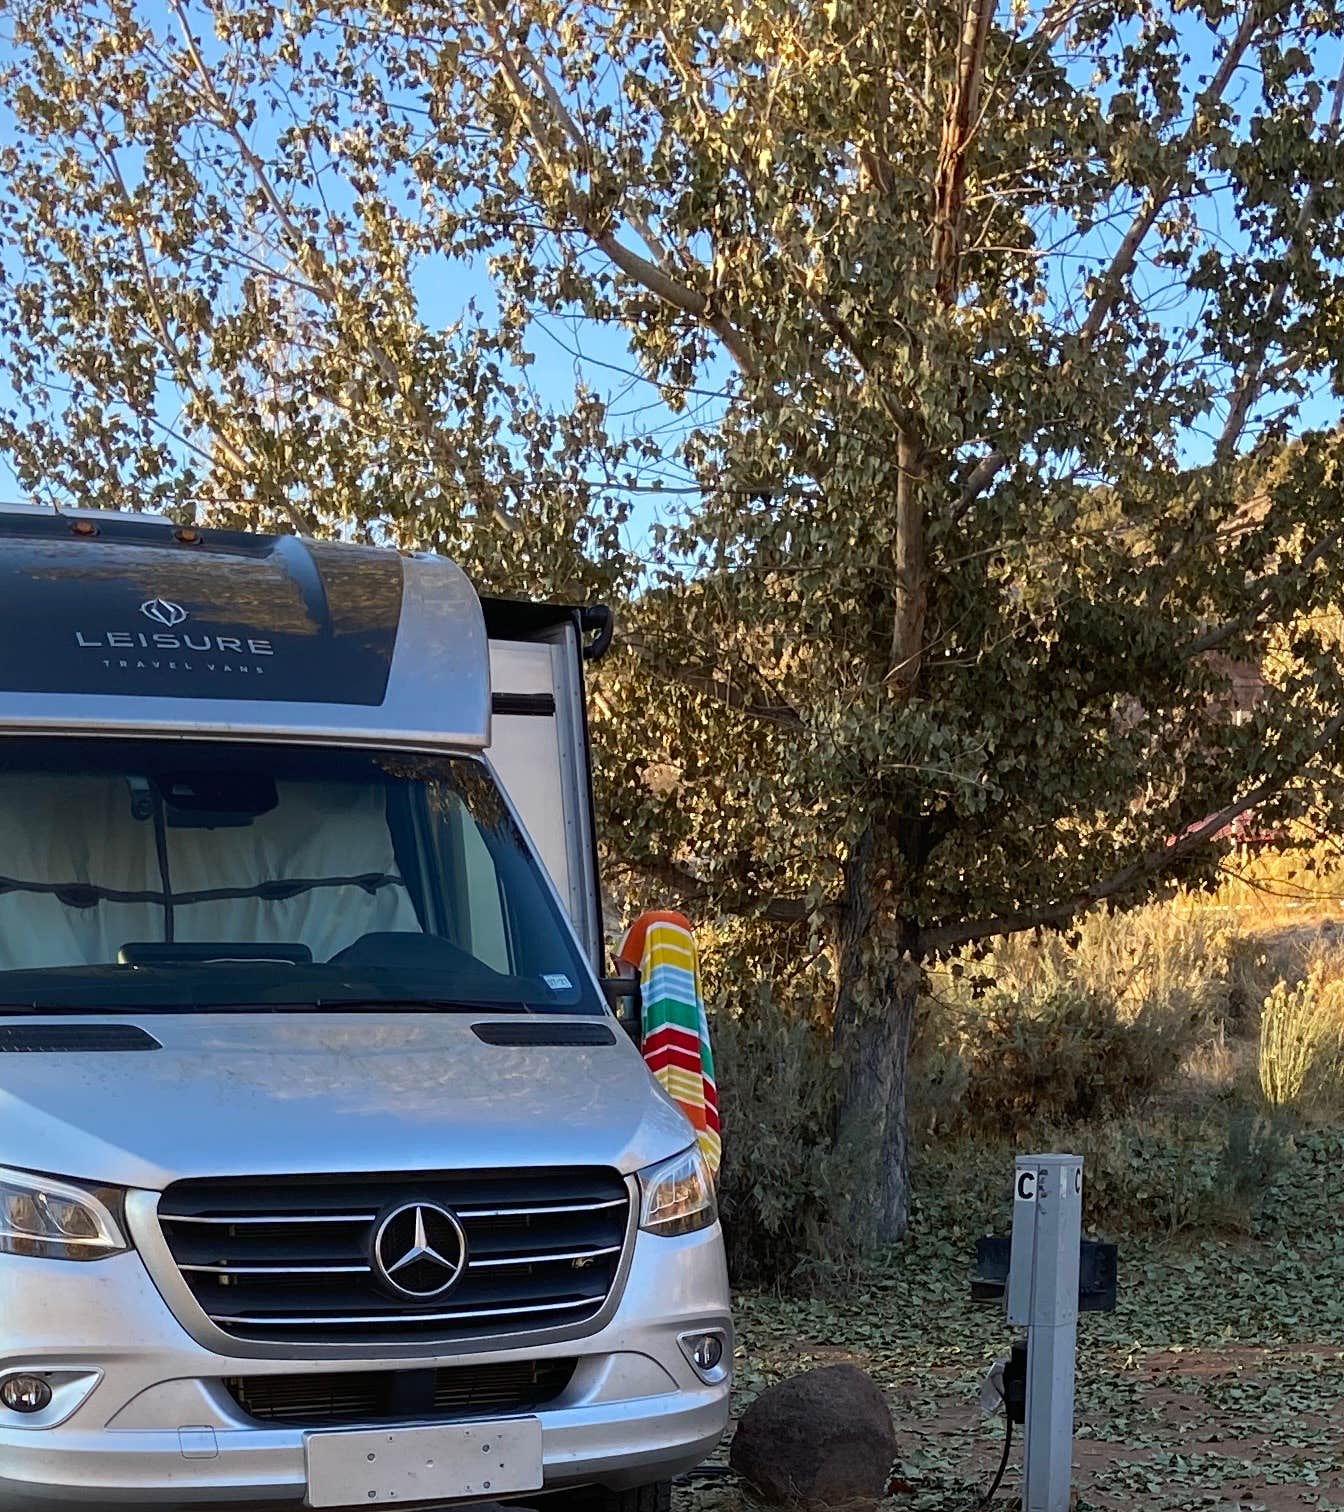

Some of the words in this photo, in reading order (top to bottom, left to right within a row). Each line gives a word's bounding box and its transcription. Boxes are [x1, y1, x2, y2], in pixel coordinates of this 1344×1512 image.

[75, 631, 274, 656] LEISURE
[102, 659, 193, 671] TRAVEL
[207, 663, 265, 675] VANS
[1017, 1172, 1035, 1199] C
[1074, 1167, 1081, 1194] C
